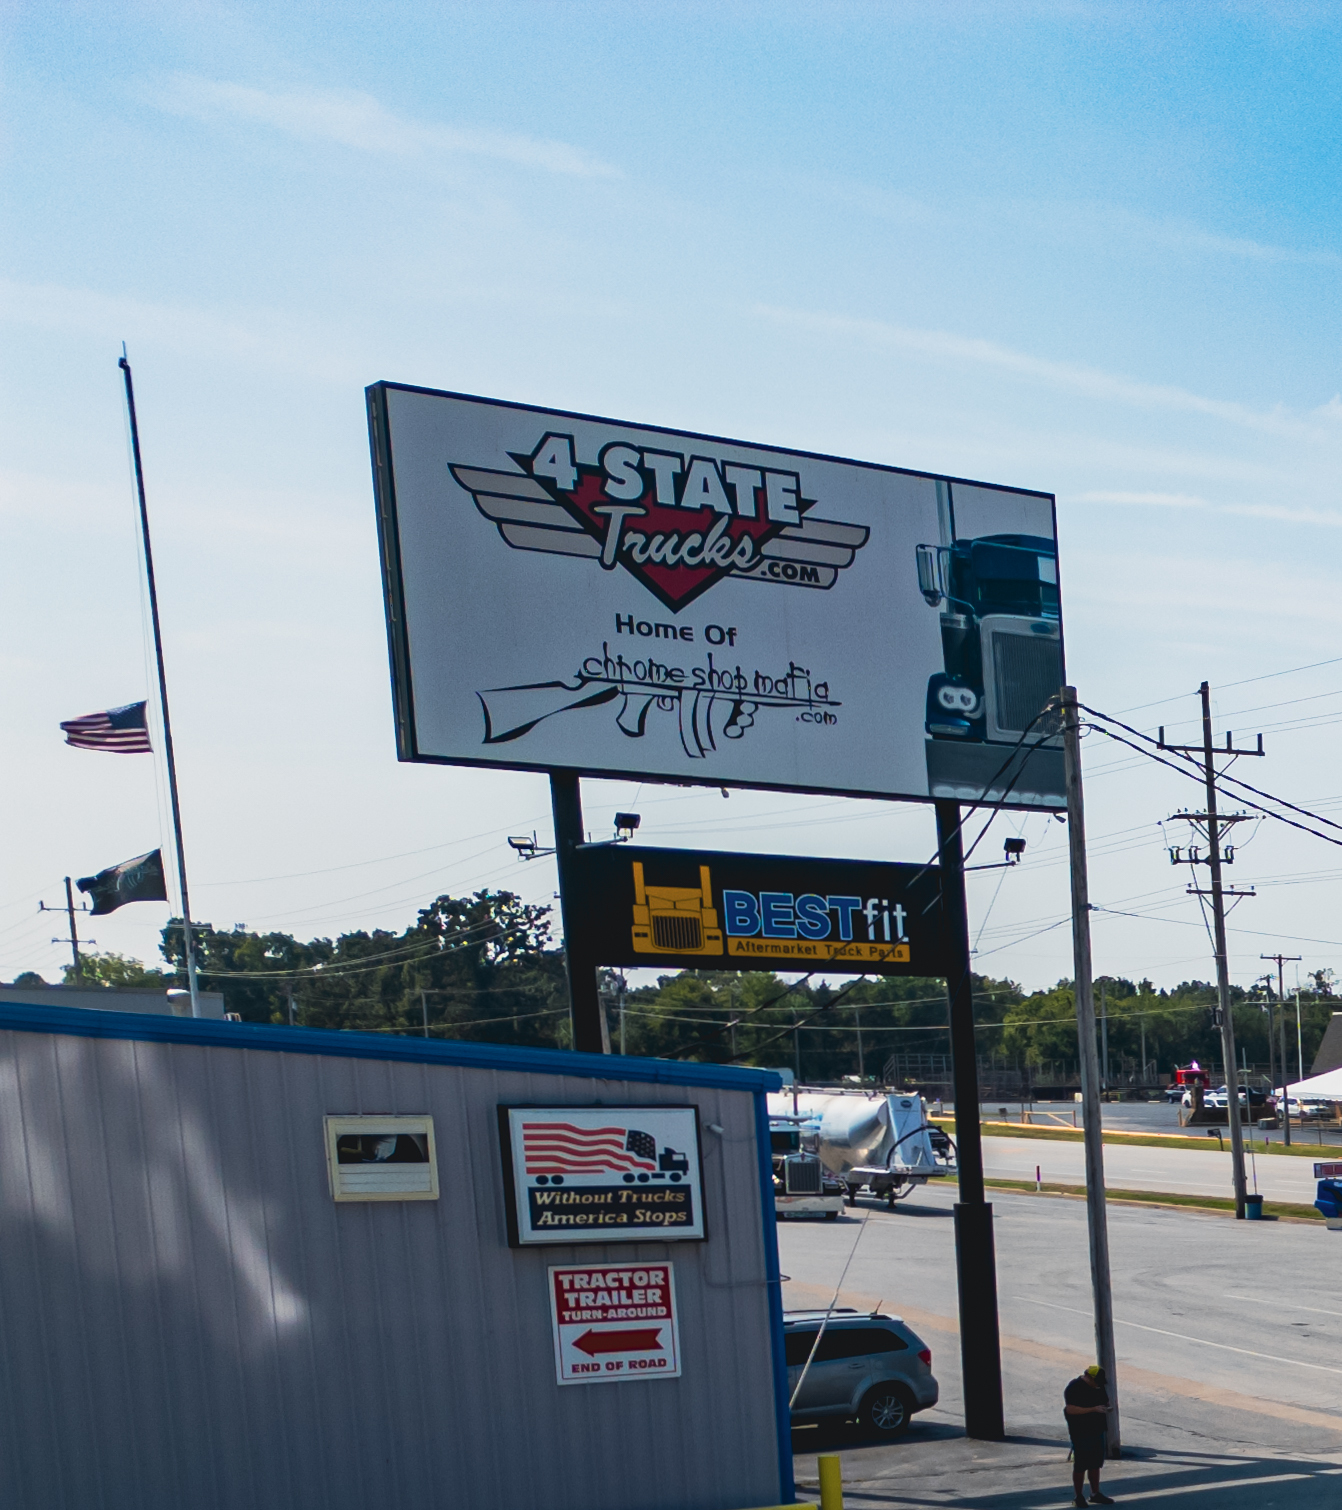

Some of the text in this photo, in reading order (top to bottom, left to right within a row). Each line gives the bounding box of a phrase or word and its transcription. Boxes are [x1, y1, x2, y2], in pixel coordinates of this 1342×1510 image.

[531, 432, 804, 525] 4 STATE
[593, 504, 761, 570] Trucks
[615, 613, 737, 648] Home Of
[582, 642, 830, 709] chrome shop mafia
[794, 708, 838, 726] .com
[736, 940, 904, 960] Aftermarket Truck Parts
[535, 1189, 685, 1206] Without Trucks
[537, 1208, 687, 1227] America Stops
[558, 1270, 665, 1290] TRACTOR
[564, 1289, 663, 1308] TRAILER
[562, 1305, 667, 1322] TURN-AROUND
[571, 1357, 667, 1374] END OF ROAD
